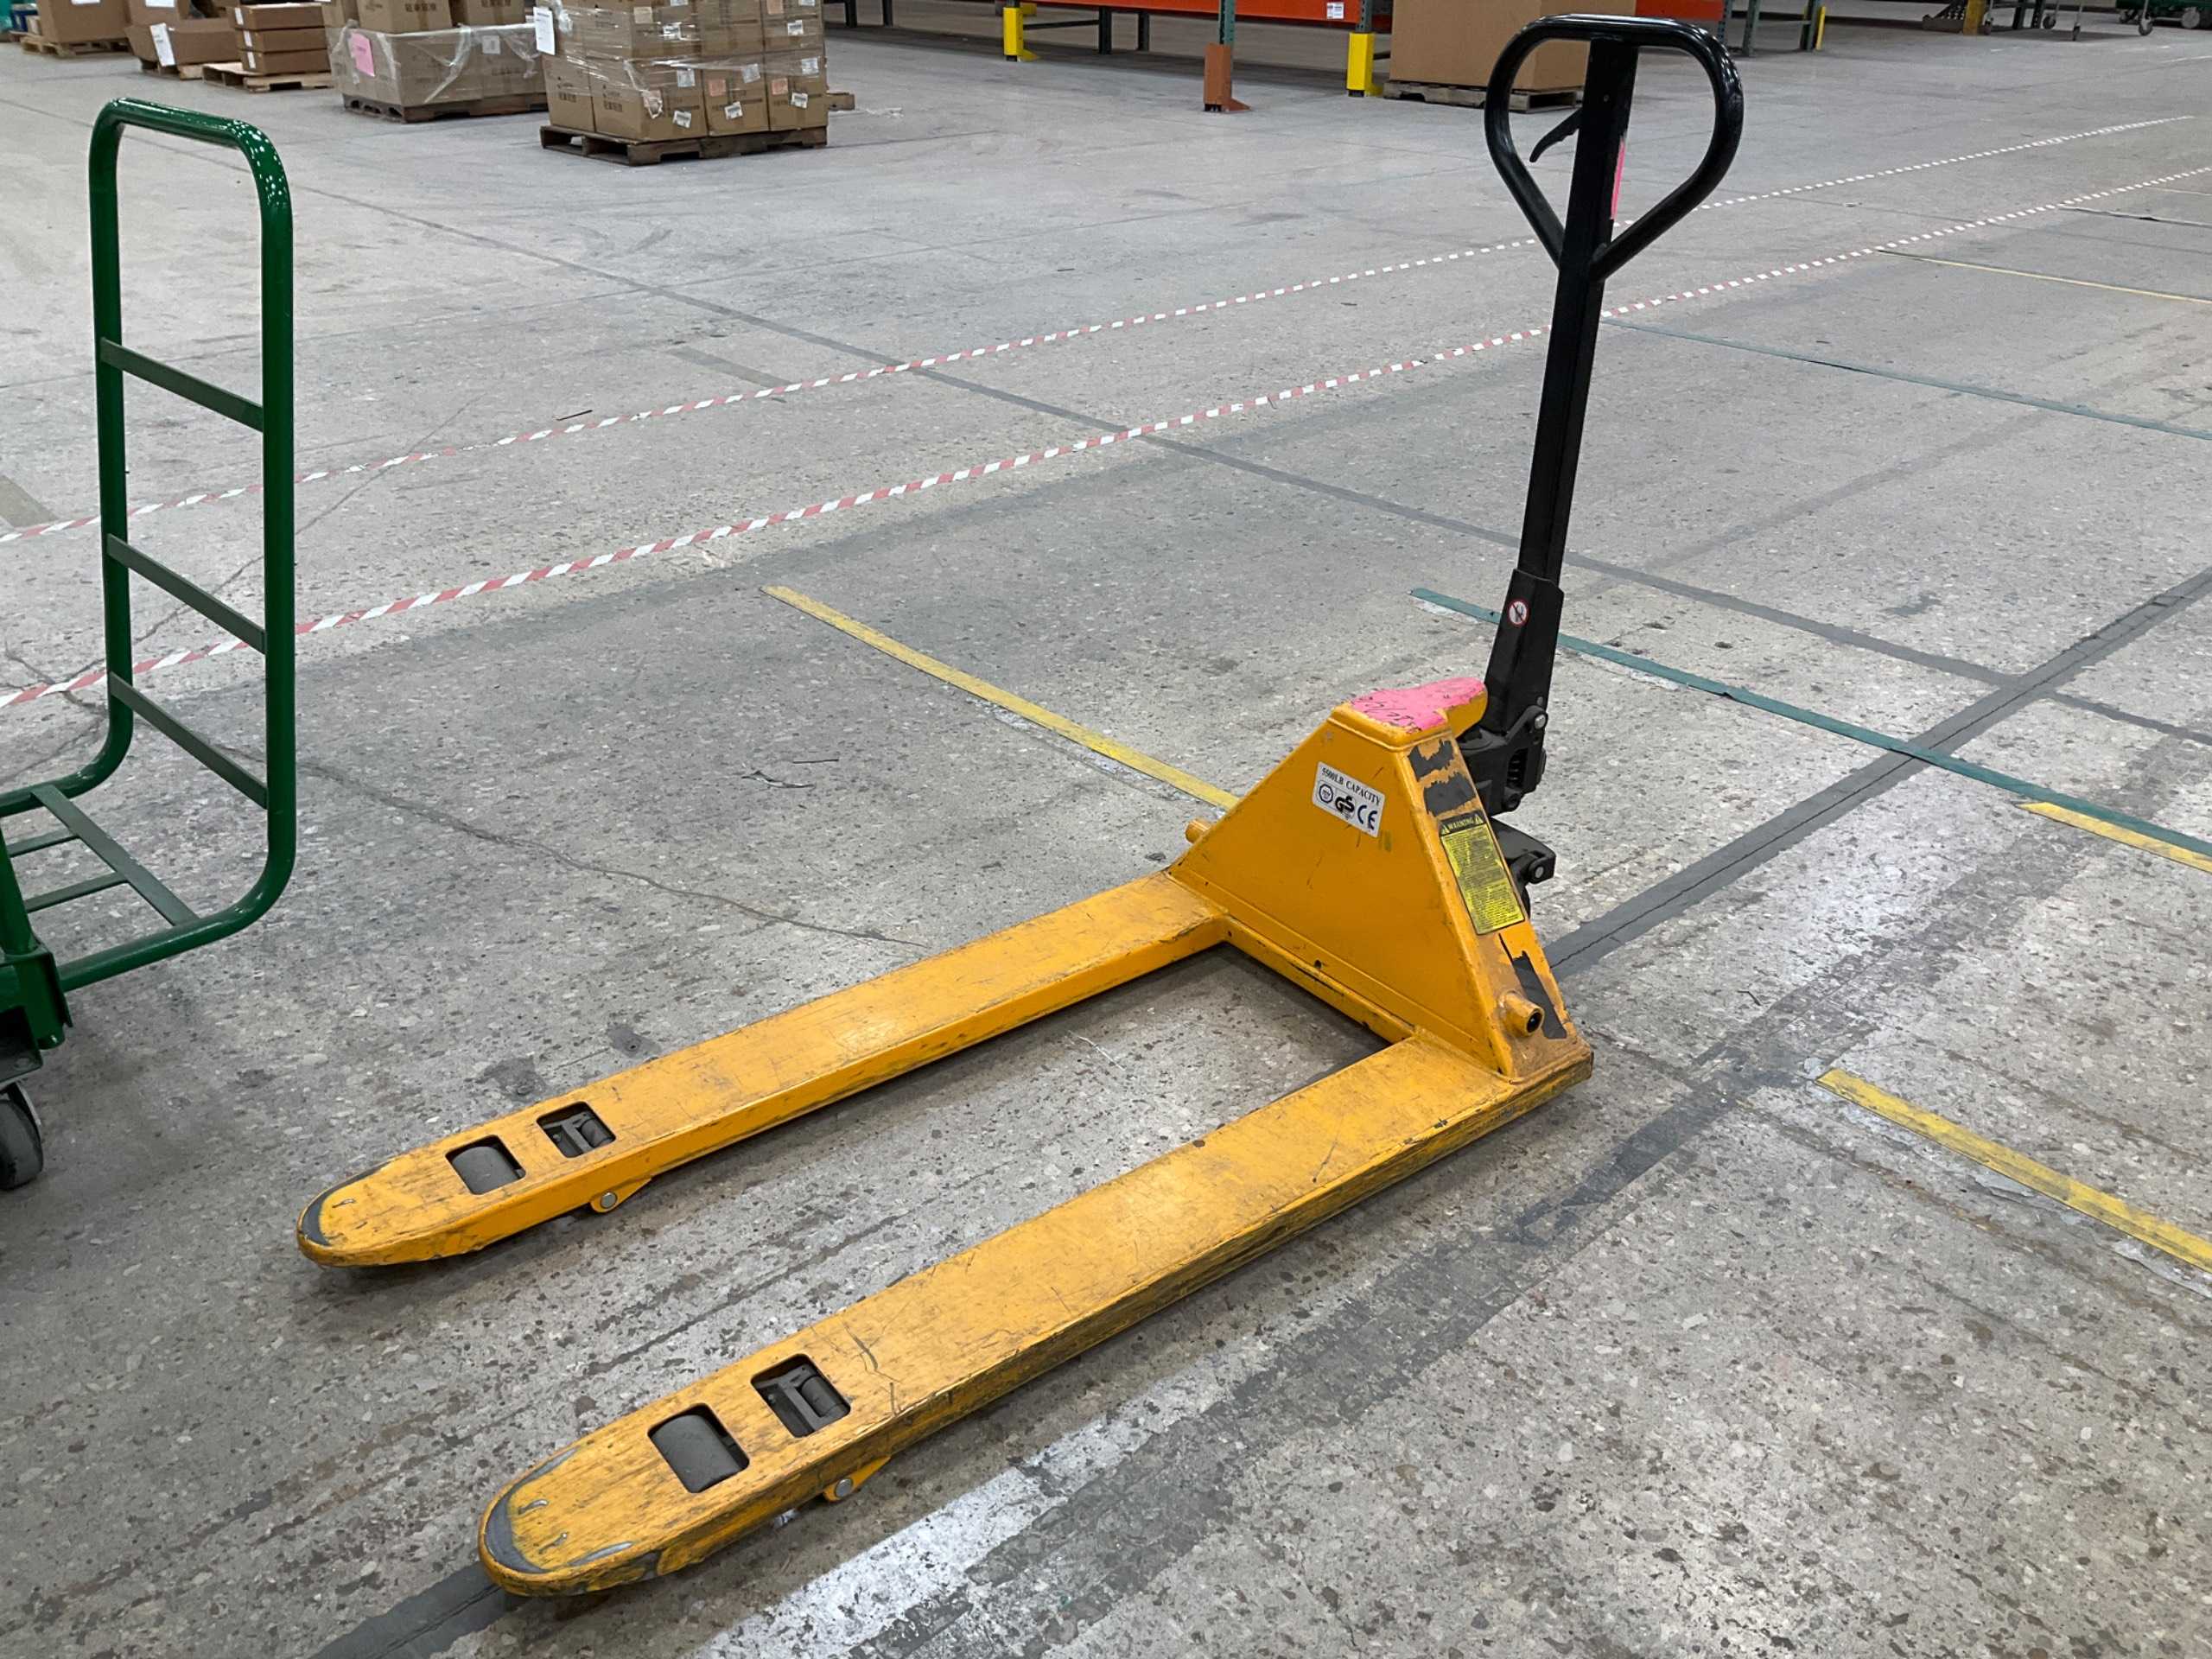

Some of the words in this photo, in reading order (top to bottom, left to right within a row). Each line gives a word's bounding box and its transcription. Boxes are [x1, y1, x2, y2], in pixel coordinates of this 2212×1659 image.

[1346, 780, 1381, 805] CAPACITY
[1335, 795, 1355, 813] GS
[1357, 804, 1378, 830] CE
